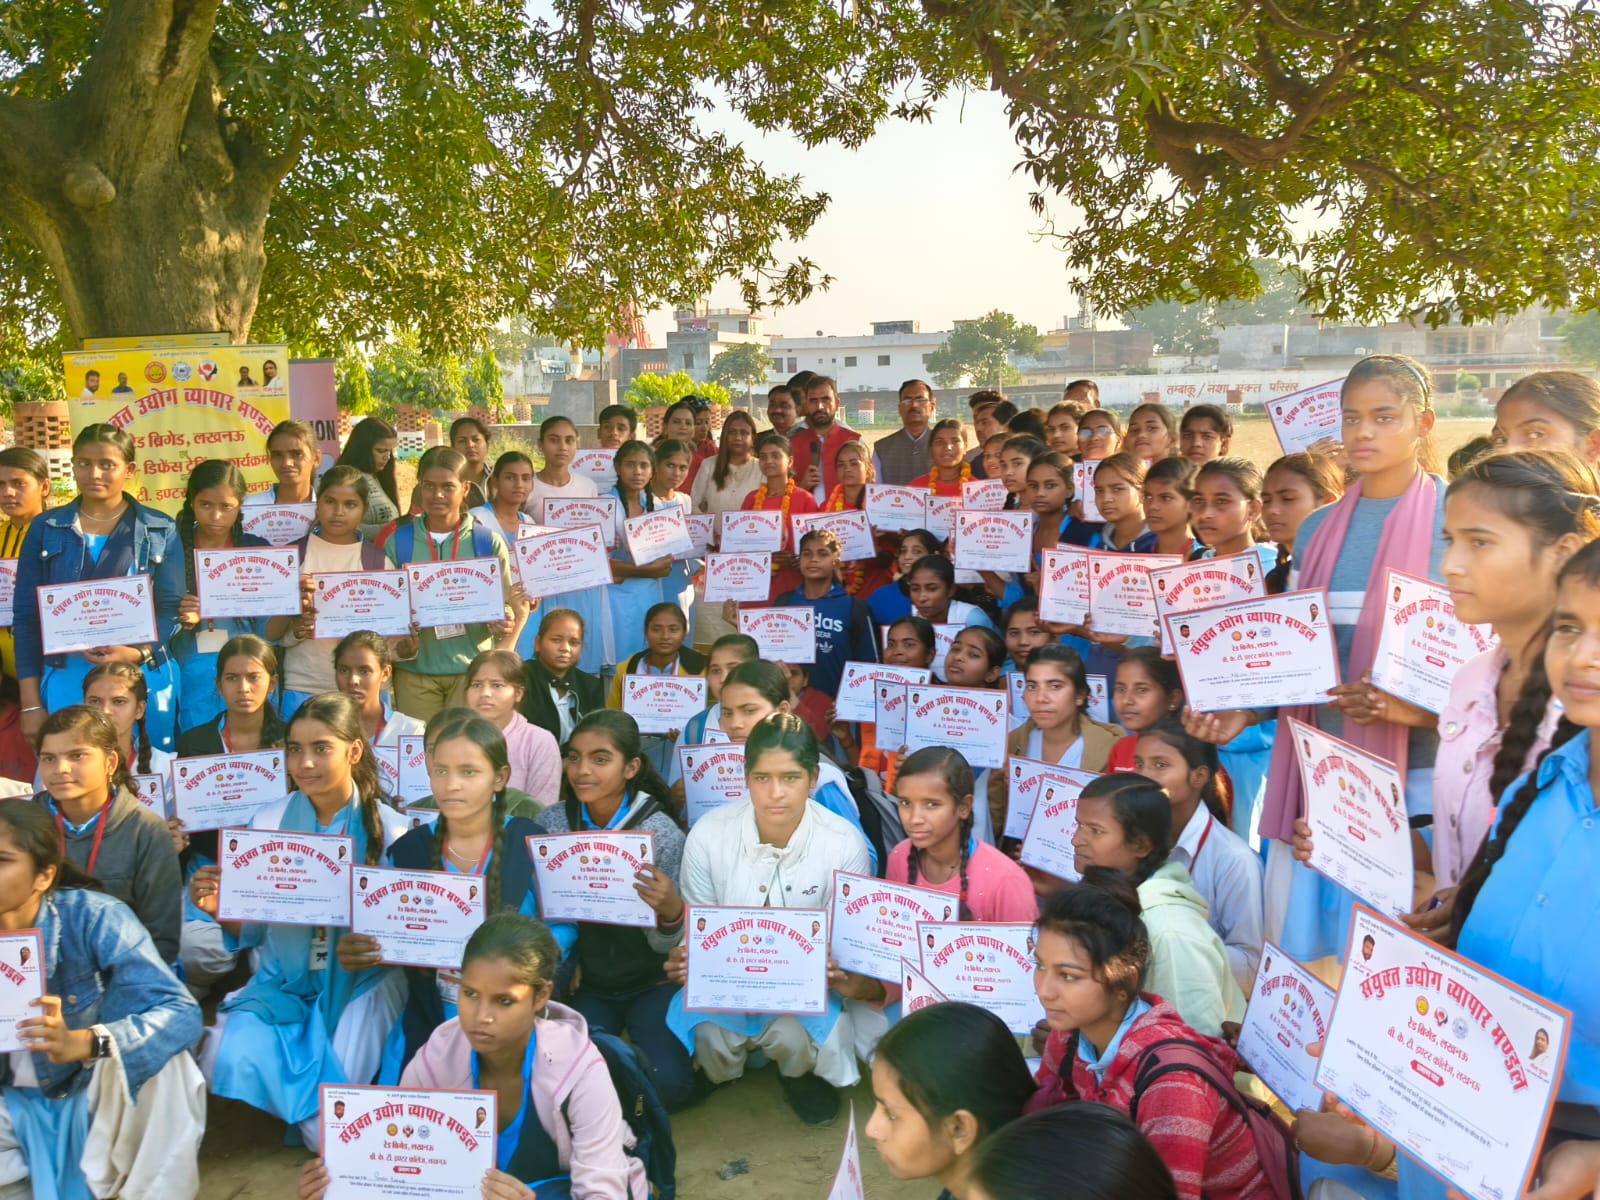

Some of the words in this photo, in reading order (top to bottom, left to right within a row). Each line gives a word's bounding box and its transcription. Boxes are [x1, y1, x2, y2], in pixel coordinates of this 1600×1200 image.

[1208, 383, 1229, 393] नशा
[1269, 379, 1299, 392] परिसर
[106, 406, 134, 430] क्त
[135, 388, 178, 415] उद्योग
[184, 388, 234, 412] व्यापार
[148, 431, 190, 447] ब्रिगेड,
[194, 430, 246, 444] लखनऊ
[144, 460, 183, 475] डिफेंस
[137, 487, 152, 502] टी.
[245, 481, 272, 493] खनऊ
[299, 514, 314, 525] मण्
[1133, 562, 1150, 575] व्याप
[1191, 626, 1217, 655] संयुक्त
[1216, 613, 1244, 632] उद्योग
[1247, 612, 1281, 625] व्यापार
[1284, 615, 1318, 642] मण्डल
[1443, 600, 1456, 617] व्या
[1464, 623, 1487, 653] मण्ड
[728, 752, 746, 763] व्यापा
[232, 848, 258, 870] संयुक्त
[260, 840, 284, 854] उद्योग
[287, 842, 315, 856] व्यापार
[316, 851, 342, 876] मण्डल
[546, 850, 569, 872] संयुक्त
[570, 841, 591, 857] उद्योग
[593, 841, 620, 857] व्यापार
[621, 851, 642, 873] मण्डल
[363, 887, 389, 908] संयुक्त
[390, 878, 414, 893] उद्योग
[416, 880, 445, 895] व्यापार
[446, 890, 472, 916] मण्डल
[922, 906, 937, 922] मण्
[700, 927, 729, 952] संयुक्त
[729, 916, 754, 934] उद्योग
[757, 918, 787, 934] व्यापार
[787, 929, 815, 956] मण्डल
[932, 943, 955, 968] संयुक्त
[955, 933, 974, 948] उद्योग
[976, 935, 1004, 952] व्यापार
[1005, 944, 1033, 974] मण्डल
[1360, 972, 1400, 1000] संयुक्त
[1405, 962, 1443, 992] उद्योग
[1446, 977, 1494, 1028] व्यापार
[1491, 1022, 1529, 1092] मण्डल
[1407, 1016, 1419, 1032] रेड
[1417, 1021, 1439, 1046] ब्रिगेड,
[1440, 1035, 1469, 1063] लखनऊ
[338, 1113, 372, 1144] संयुक्त
[373, 1102, 404, 1120] उद्योग
[408, 1104, 444, 1124] व्यापार
[446, 1116, 479, 1152] मण्डल
